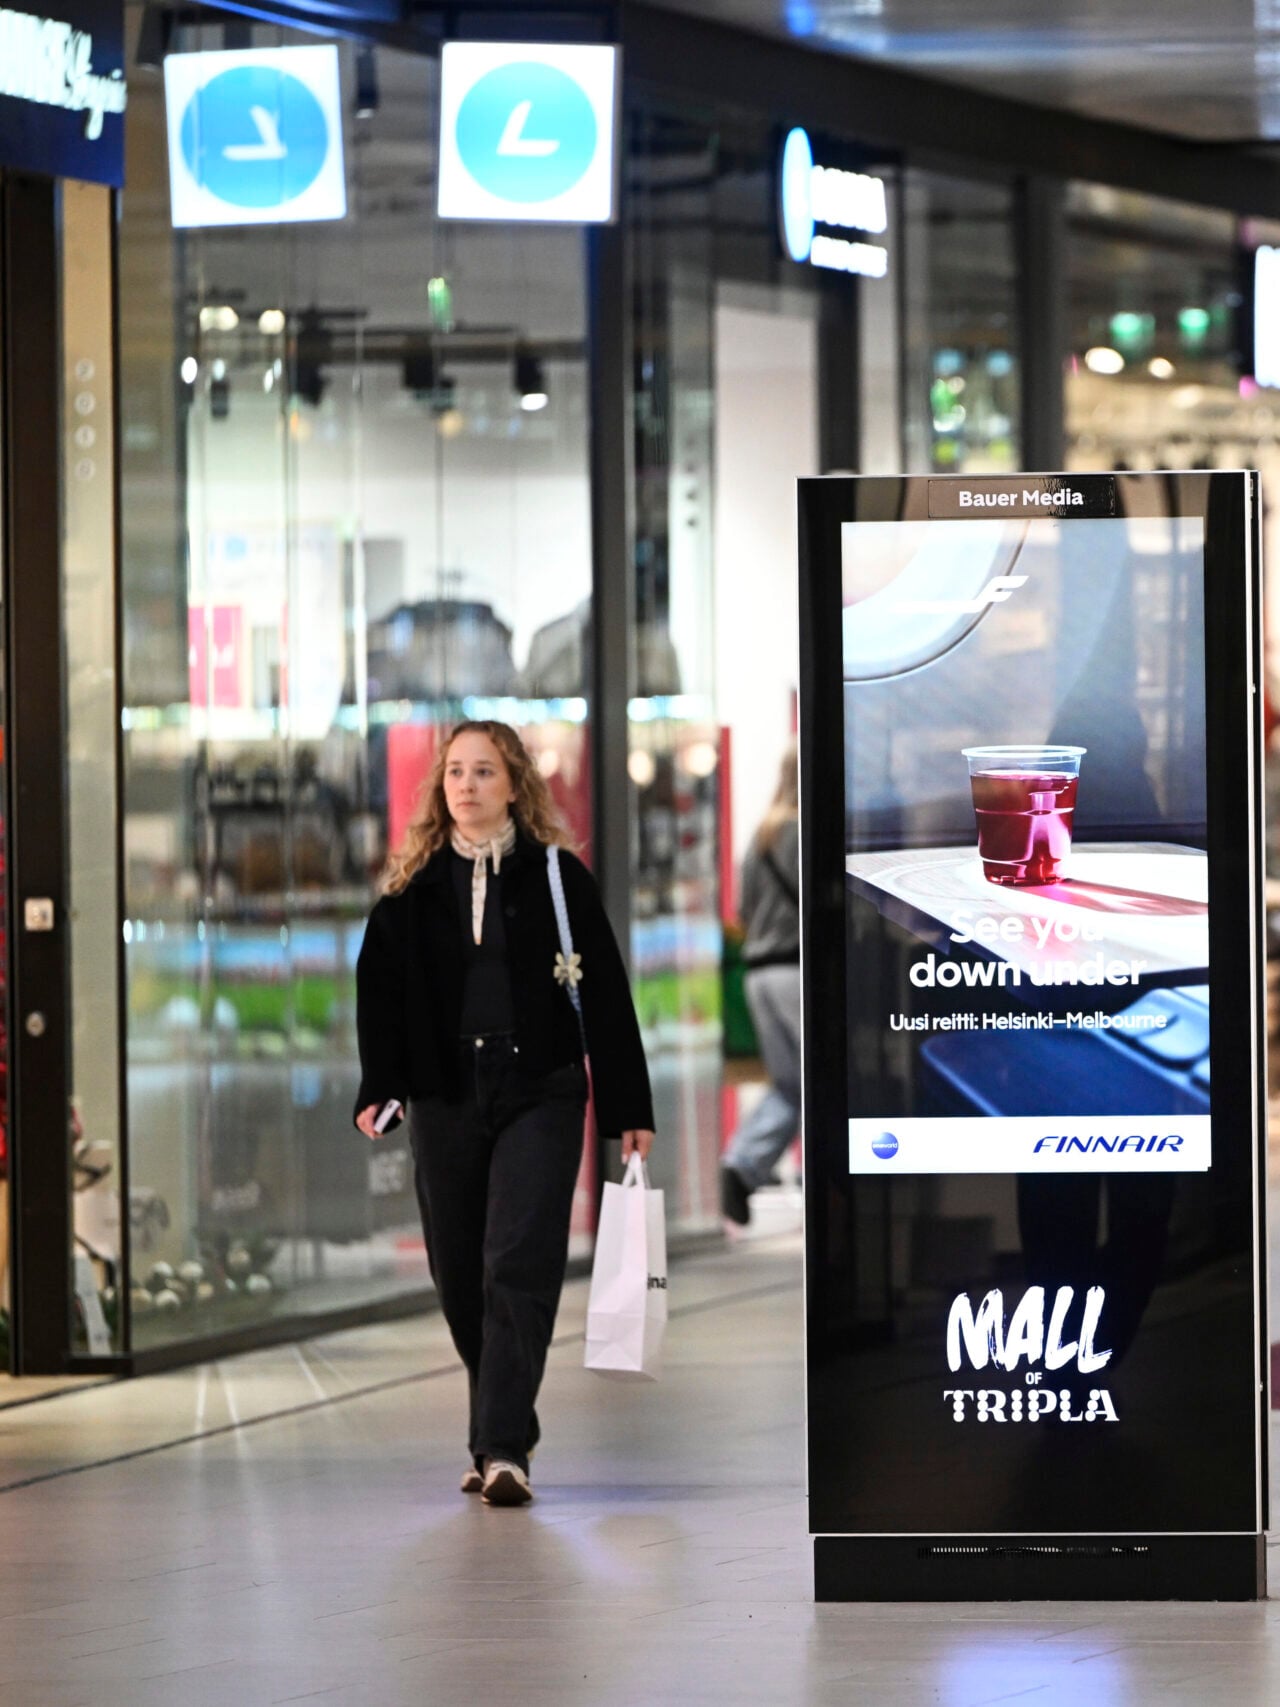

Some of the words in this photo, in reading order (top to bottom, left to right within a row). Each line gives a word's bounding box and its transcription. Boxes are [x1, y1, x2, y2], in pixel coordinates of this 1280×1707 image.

[959, 490, 1018, 507] Bauer
[1022, 488, 1084, 506] Media
[949, 909, 1024, 944] See
[1030, 917, 1104, 949] you
[909, 953, 1021, 988] down
[1029, 952, 1148, 986] under
[889, 1013, 929, 1031] Uusi
[932, 1012, 979, 1031] reitti:
[1033, 1134, 1184, 1153] FINNAIR
[946, 1285, 1113, 1374] MALL
[1024, 1371, 1043, 1385] OF
[943, 1389, 1120, 1423] TRIPLA
